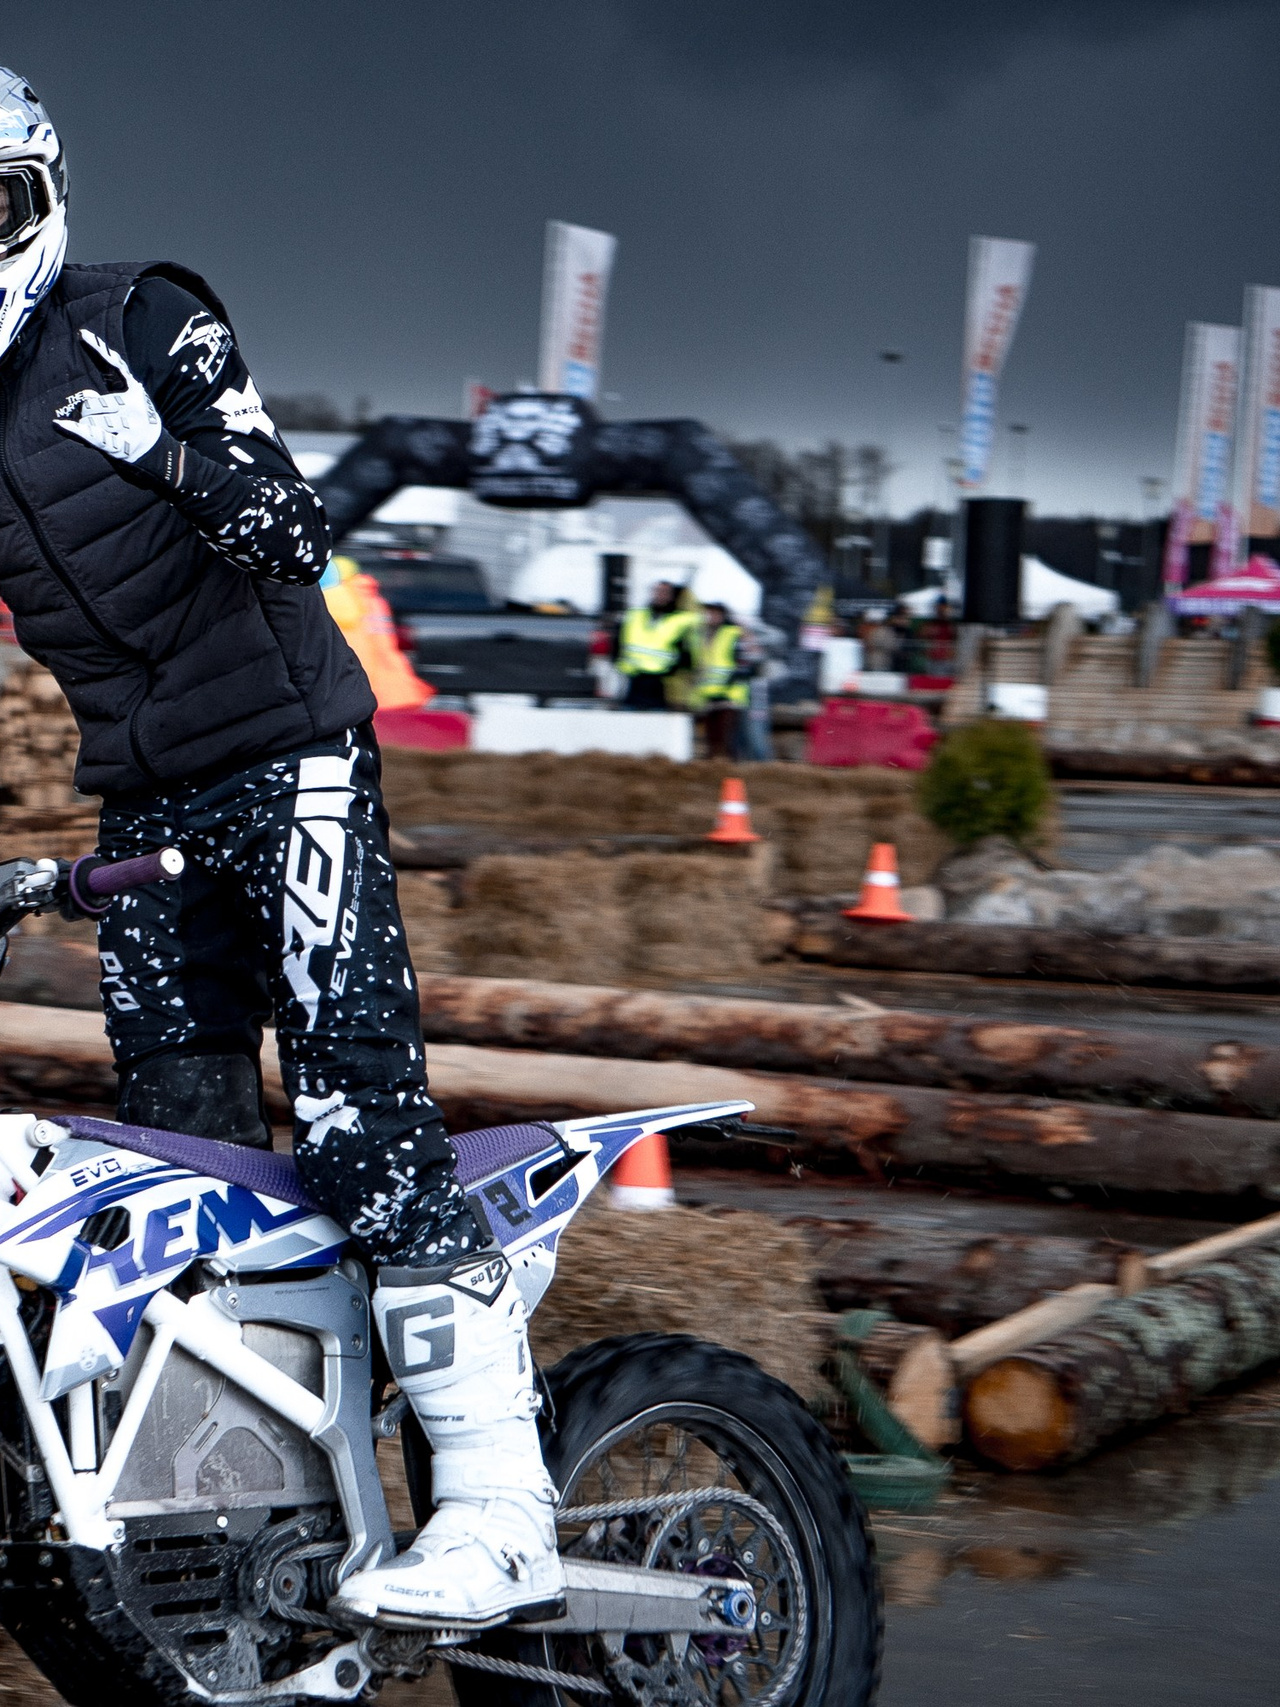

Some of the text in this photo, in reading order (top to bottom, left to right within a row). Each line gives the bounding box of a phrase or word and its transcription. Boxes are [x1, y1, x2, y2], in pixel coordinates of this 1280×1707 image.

[65, 391, 84, 405] THE
[329, 907, 358, 998] EVO
[70, 1157, 121, 1187] EVO
[484, 1259, 504, 1284] 12
